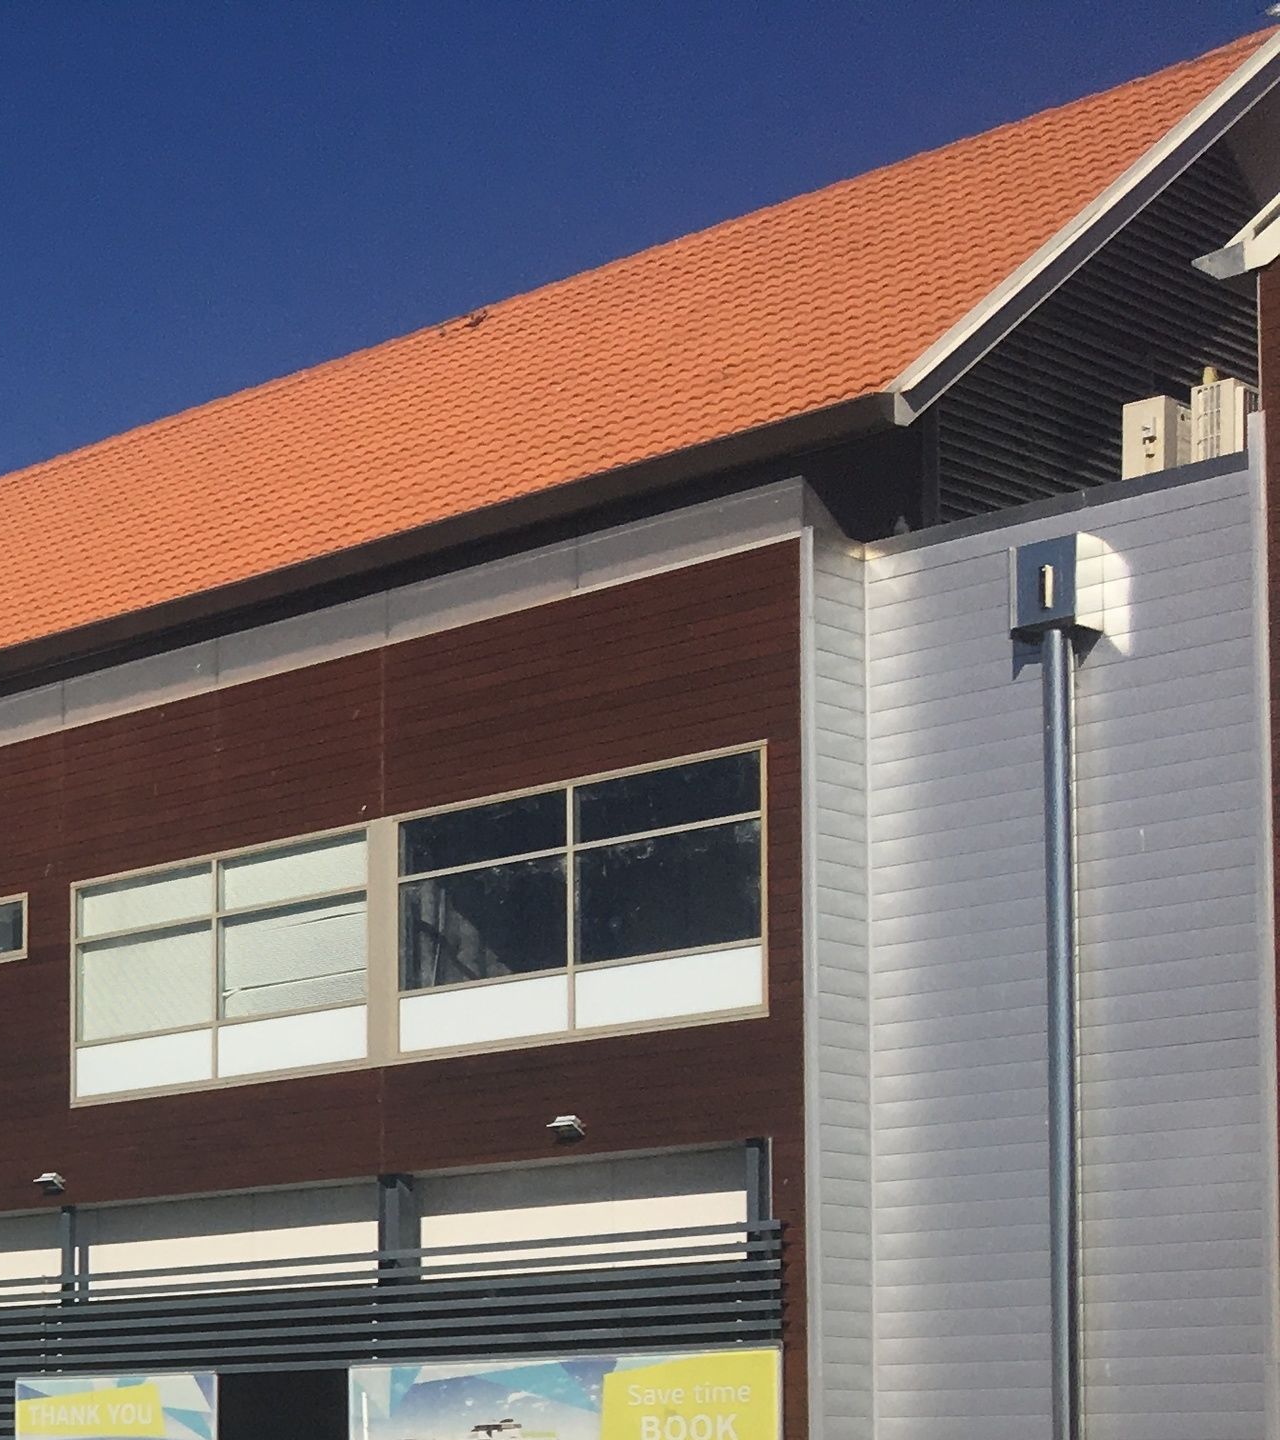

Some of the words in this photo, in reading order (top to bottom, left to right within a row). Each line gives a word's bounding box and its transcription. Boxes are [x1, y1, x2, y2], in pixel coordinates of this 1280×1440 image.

[627, 1384, 685, 1407] Save
[693, 1381, 752, 1404] time
[28, 1404, 101, 1426] THANK
[107, 1402, 153, 1425] YOU
